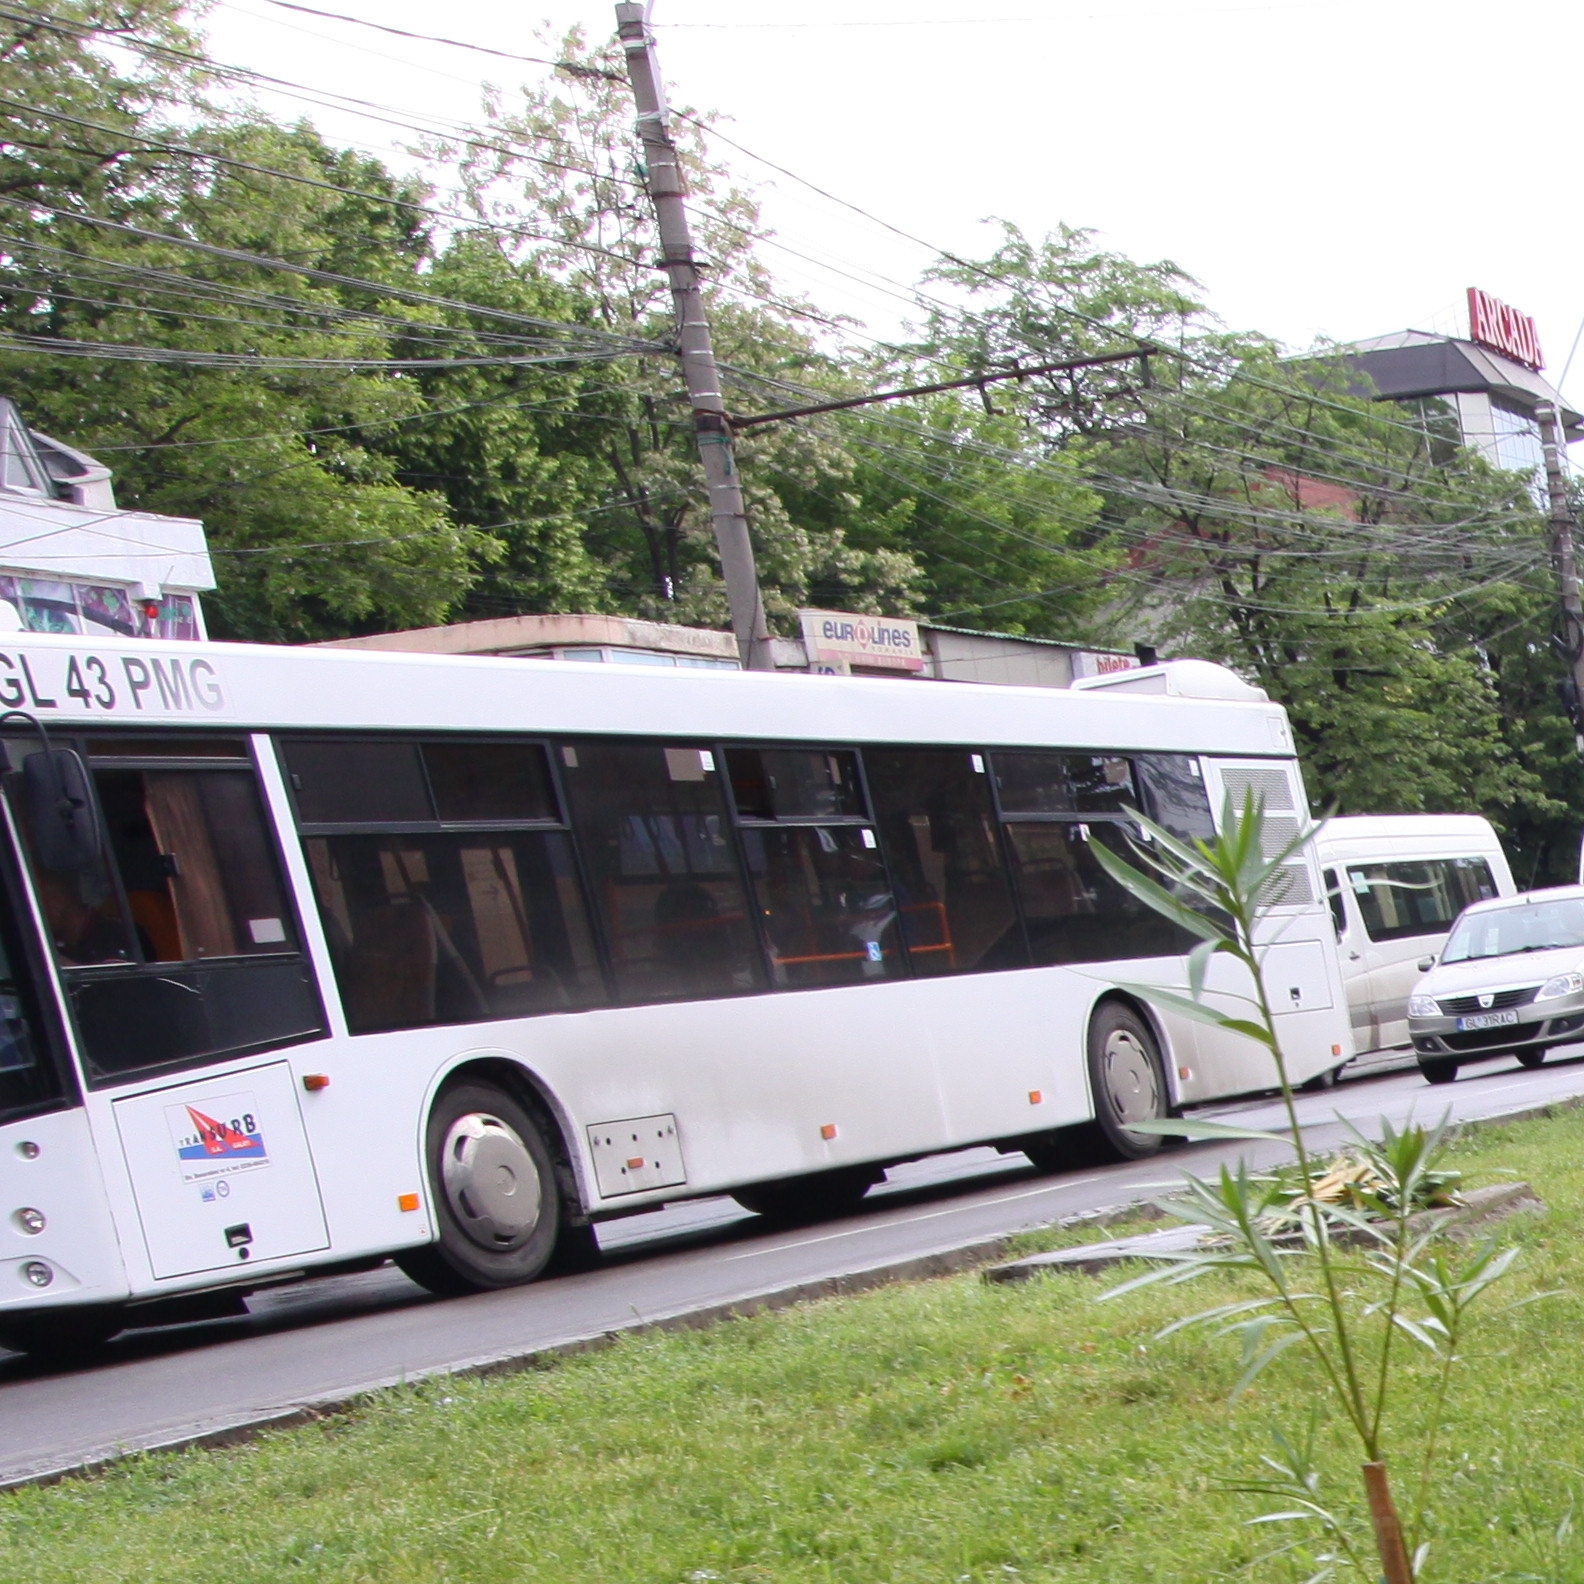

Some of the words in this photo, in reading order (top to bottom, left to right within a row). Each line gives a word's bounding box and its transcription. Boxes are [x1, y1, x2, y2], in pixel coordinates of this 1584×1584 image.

[1467, 286, 1546, 369] ARCADA
[0, 653, 58, 708] GL
[67, 654, 116, 710] 43
[121, 656, 226, 711] PMG
[1465, 1017, 1479, 1029] GL
